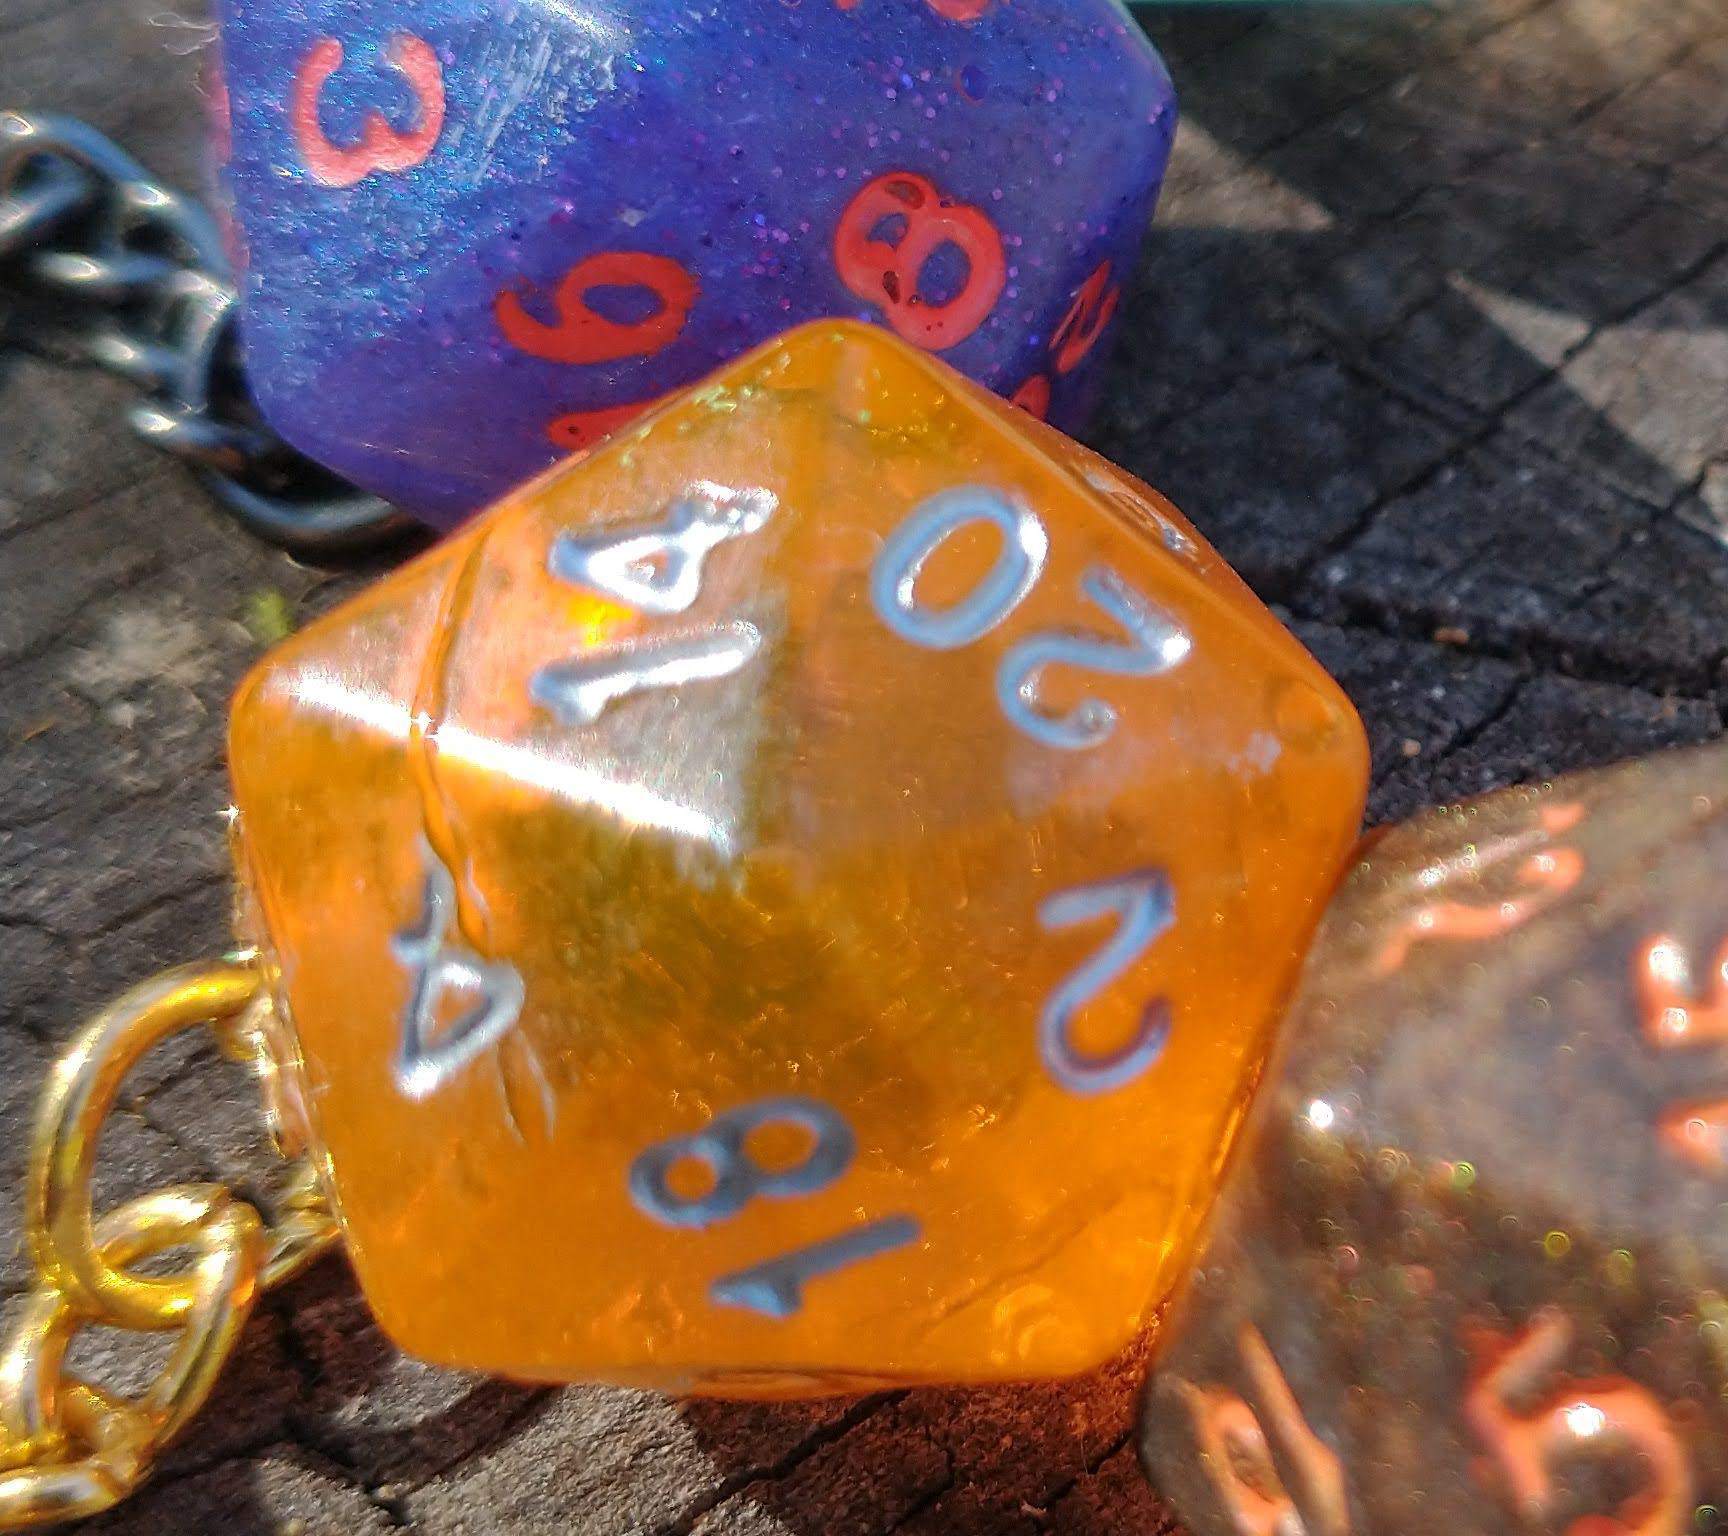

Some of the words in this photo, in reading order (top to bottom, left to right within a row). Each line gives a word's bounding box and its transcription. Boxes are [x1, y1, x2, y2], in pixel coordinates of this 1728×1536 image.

[295, 32, 446, 188] 3
[835, 170, 1005, 351] 8
[533, 479, 780, 726] 14
[872, 482, 1194, 751] 20
[392, 856, 527, 1098] 4
[1037, 866, 1179, 1096] 2
[629, 1095, 923, 1318] 18
